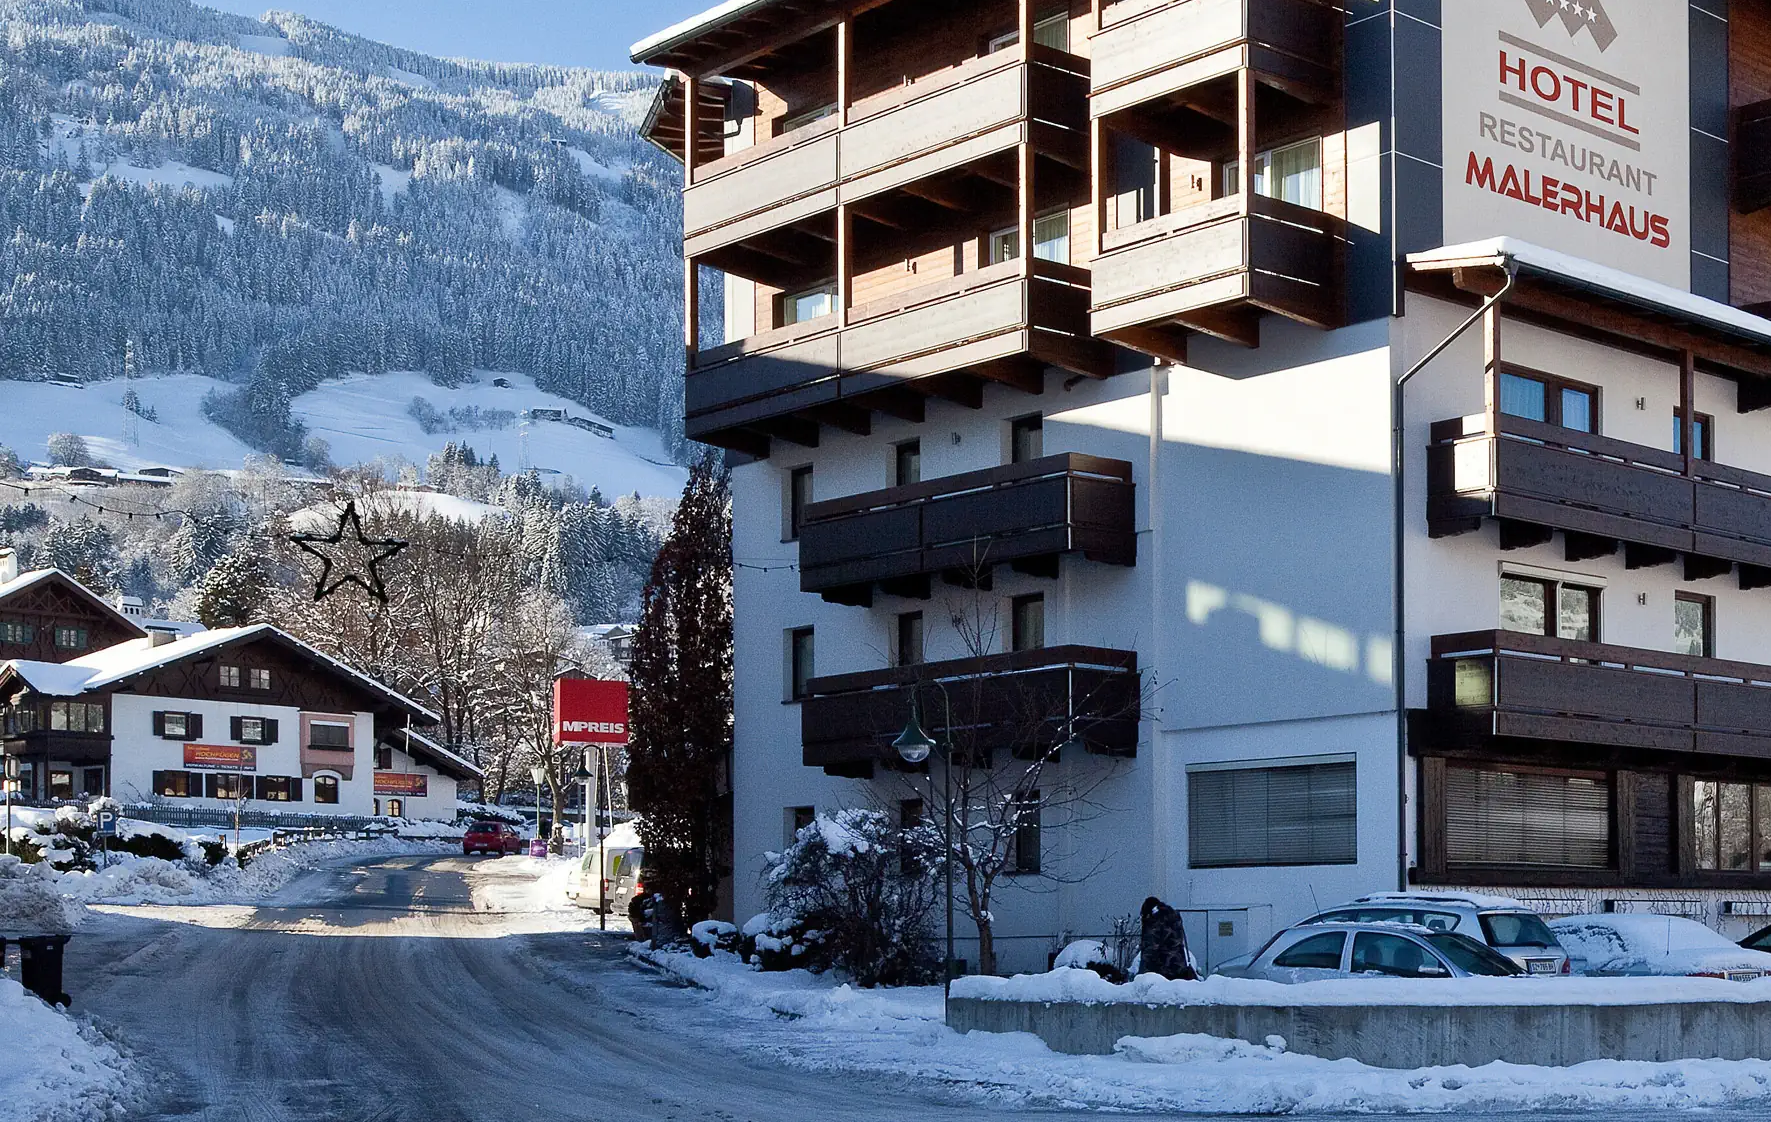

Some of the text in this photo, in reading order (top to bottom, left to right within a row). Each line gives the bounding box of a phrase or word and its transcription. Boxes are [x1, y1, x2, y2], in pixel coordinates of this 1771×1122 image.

[1499, 49, 1640, 135] HOTEL
[1479, 111, 1658, 196] RESTAURANT
[1465, 150, 1670, 249] MALERHAUS
[562, 720, 625, 734] MPREIS
[100, 812, 113, 829] P
